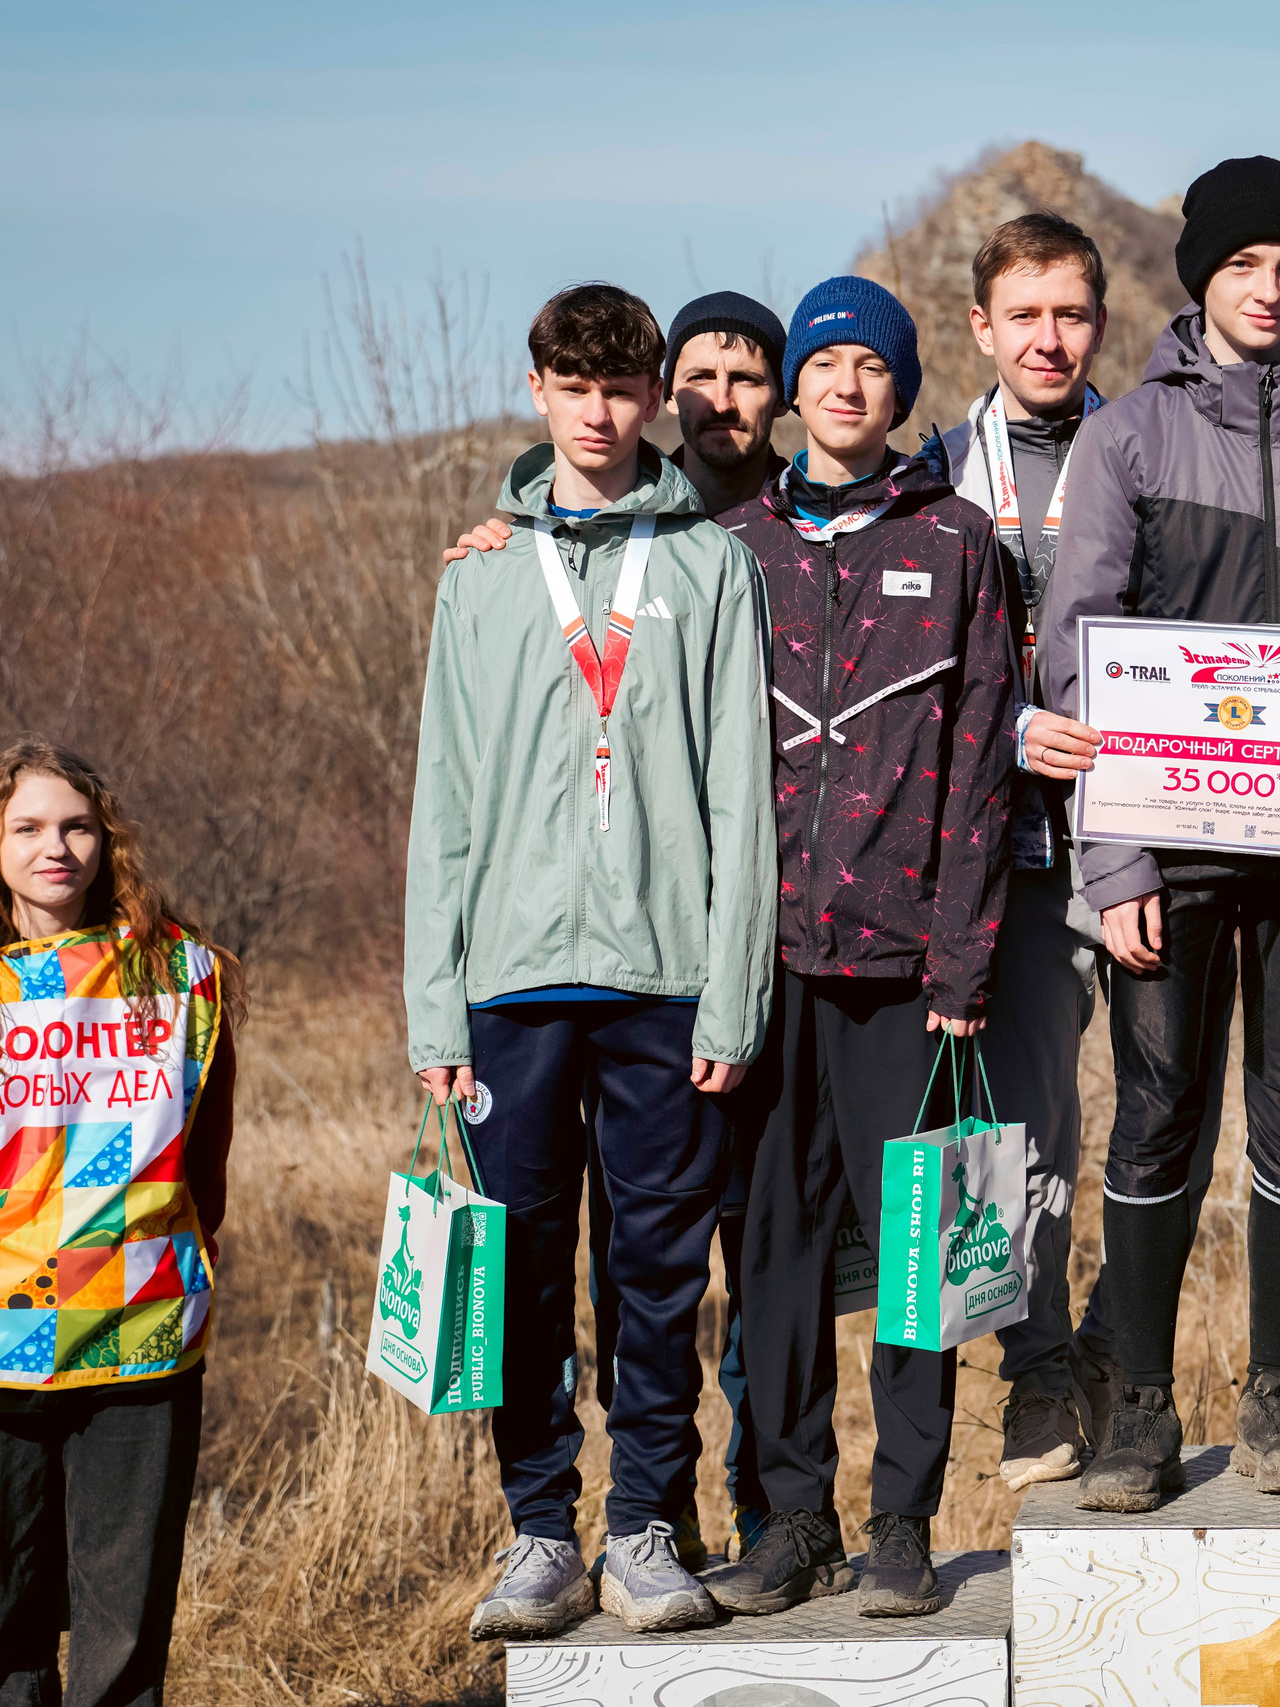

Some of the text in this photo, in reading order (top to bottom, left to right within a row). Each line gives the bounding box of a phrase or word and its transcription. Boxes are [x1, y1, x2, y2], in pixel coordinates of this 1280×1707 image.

[814, 311, 846, 325] VOLUME ON
[901, 581, 922, 591] nike
[1178, 645, 1251, 666] Эстафета
[1106, 661, 1171, 681] O-TRAIL
[1217, 673, 1266, 683] ПОКОЛЕНИЙ
[1191, 683, 1241, 692] ТРЕЙЛ-ЭСТАФЕТА
[1231, 706, 1241, 719] L
[1107, 735, 1234, 758] ПОДАРОЧНЫЙ
[1163, 767, 1200, 792] 35
[1098, 800, 1141, 809] Туристического
[1142, 803, 1171, 811] комплекса
[108, 1068, 173, 1109] ДЕЛ
[904, 1149, 925, 1341] BIONOVA-SHOP.RU
[946, 1235, 1011, 1274] bionova
[380, 1275, 420, 1330] bionova
[968, 1278, 1018, 1311] ДНЯ ОСНОВА
[448, 1264, 465, 1405] ПОДПИШИСЬ
[472, 1266, 488, 1402] PUBLIC_BIONOVA
[382, 1337, 421, 1374] ДНЯ ОСНОВА
